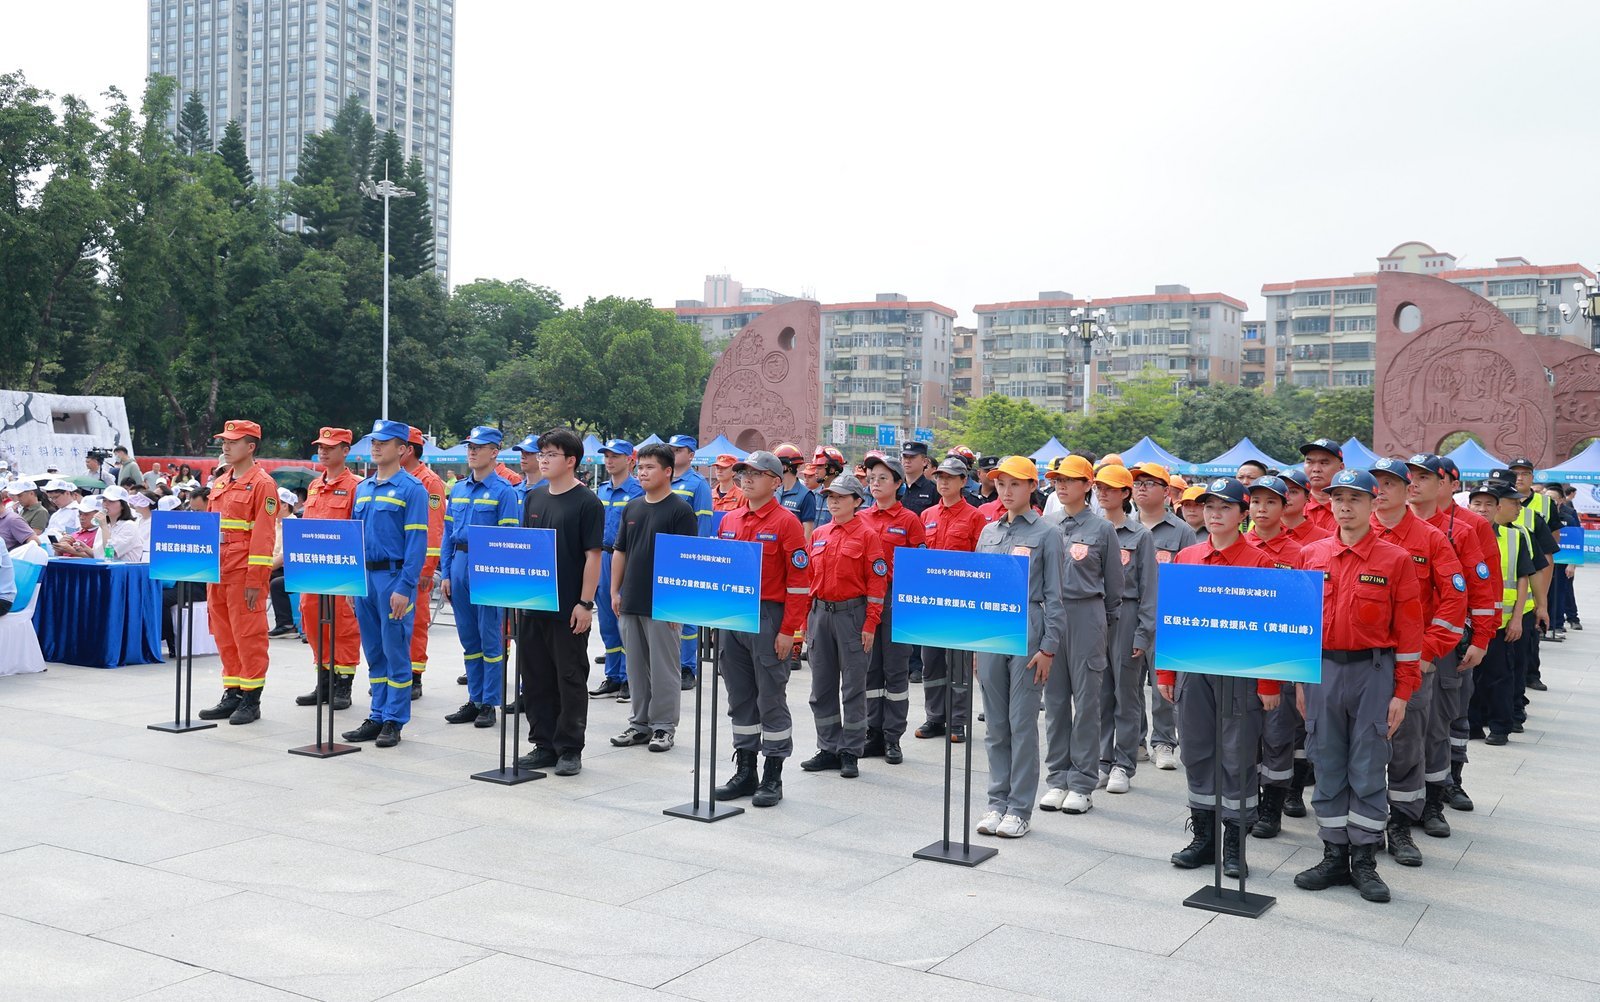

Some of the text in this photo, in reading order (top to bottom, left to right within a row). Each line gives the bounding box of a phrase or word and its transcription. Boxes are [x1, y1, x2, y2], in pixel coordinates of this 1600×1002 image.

[155, 542, 214, 554] 黄埔区森林消防大队
[289, 552, 358, 566] 黄埔区特种救援大队
[680, 552, 732, 564] 2026年全国防灾减灾日
[926, 567, 991, 579] 2026年全国防灾减灾日
[657, 575, 755, 595] 区级社会力量救援队伍（广州蓝天）
[1198, 586, 1277, 598] 2026年全国防灾减灾日
[1163, 615, 1314, 636] 区级社会力量救援队伍（黄埔山峰）
